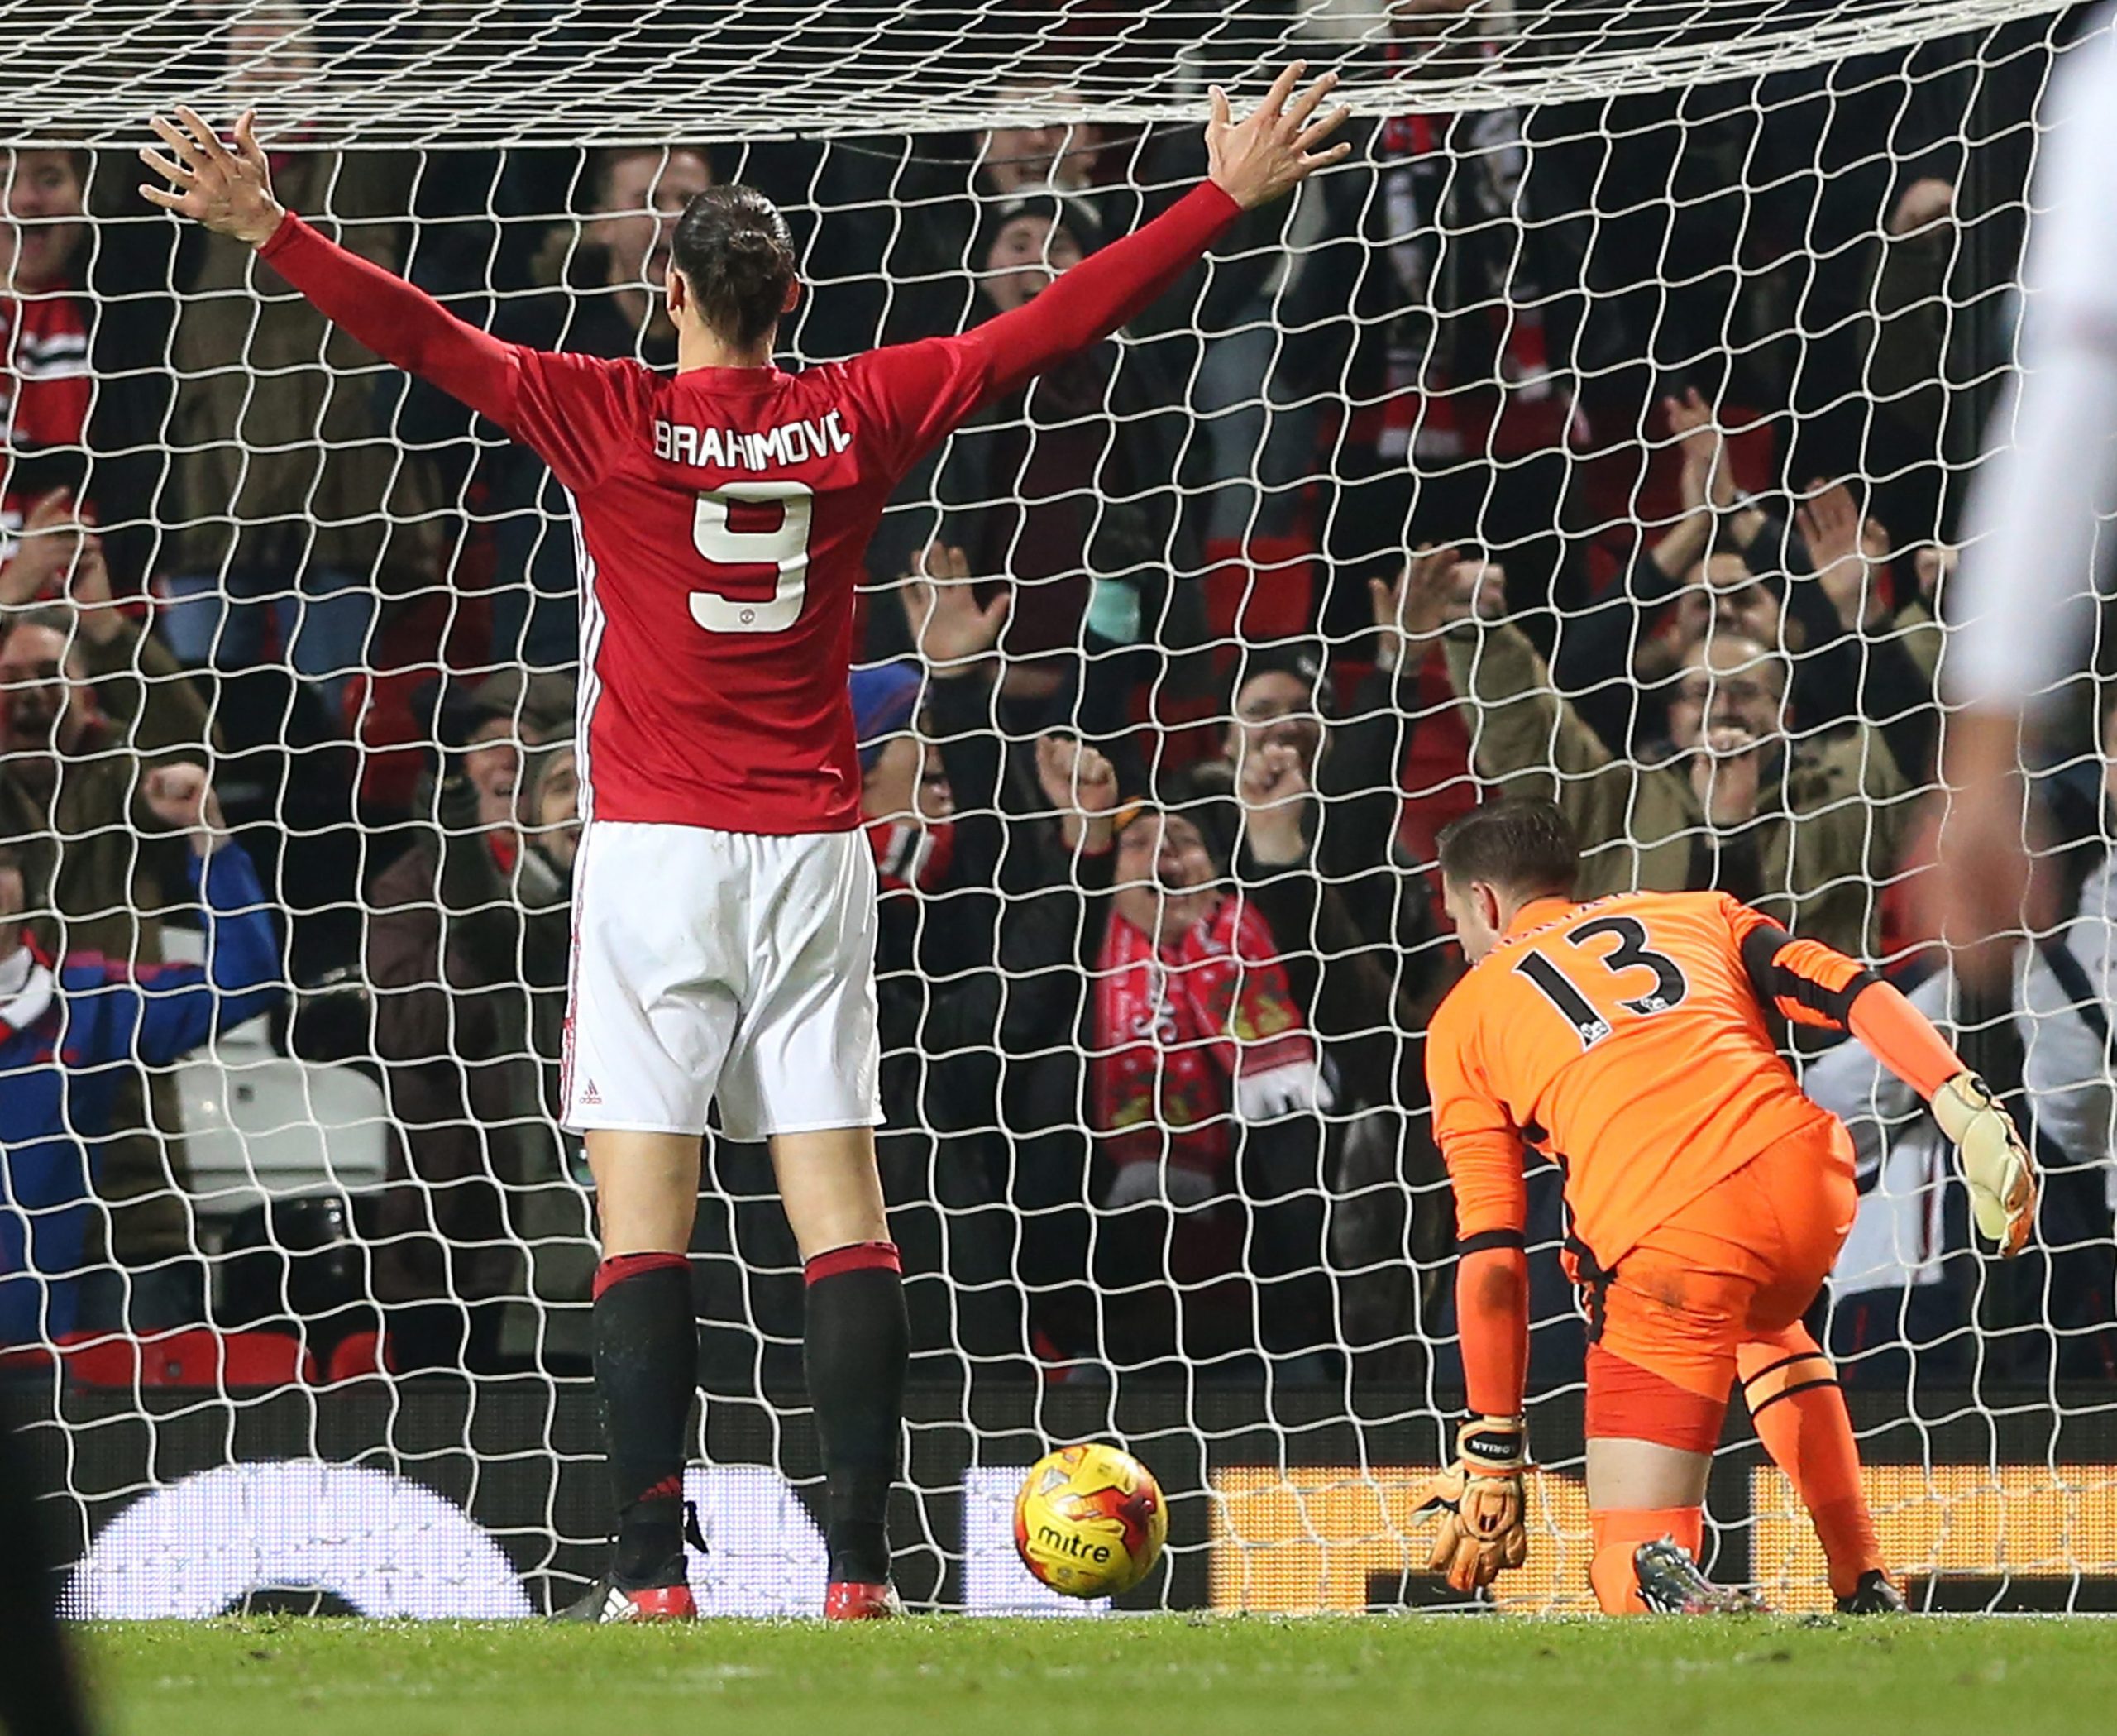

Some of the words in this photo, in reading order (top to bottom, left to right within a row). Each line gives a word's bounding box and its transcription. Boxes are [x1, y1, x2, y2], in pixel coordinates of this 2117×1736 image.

[689, 481, 815, 633] 9
[1512, 915, 1688, 1052] 13
[1037, 1525, 1111, 1563] mitre
